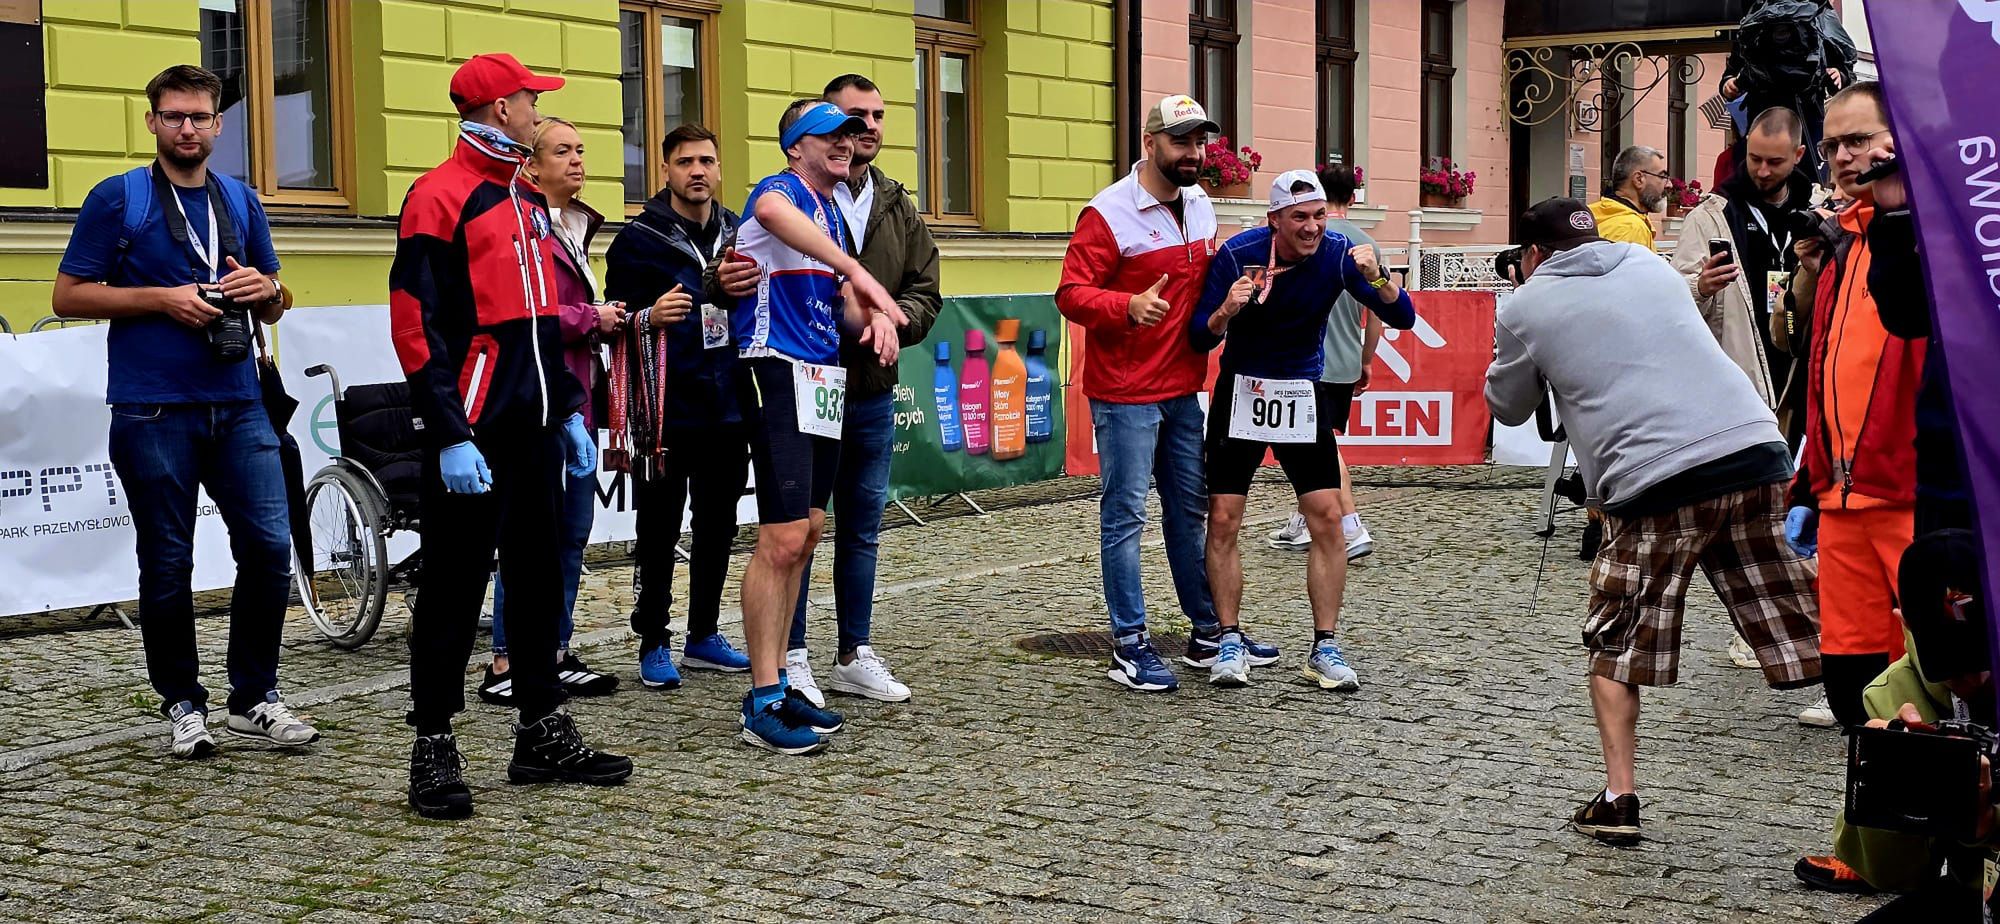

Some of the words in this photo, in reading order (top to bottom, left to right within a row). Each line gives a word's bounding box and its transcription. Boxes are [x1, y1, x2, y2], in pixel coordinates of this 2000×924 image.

[1786, 311, 1794, 335] Nikon
[1252, 397, 1297, 429] 901
[1345, 400, 1441, 437] LEN
[0, 526, 30, 540] PARK
[33, 515, 131, 537] PRZEMYSŁOWO
